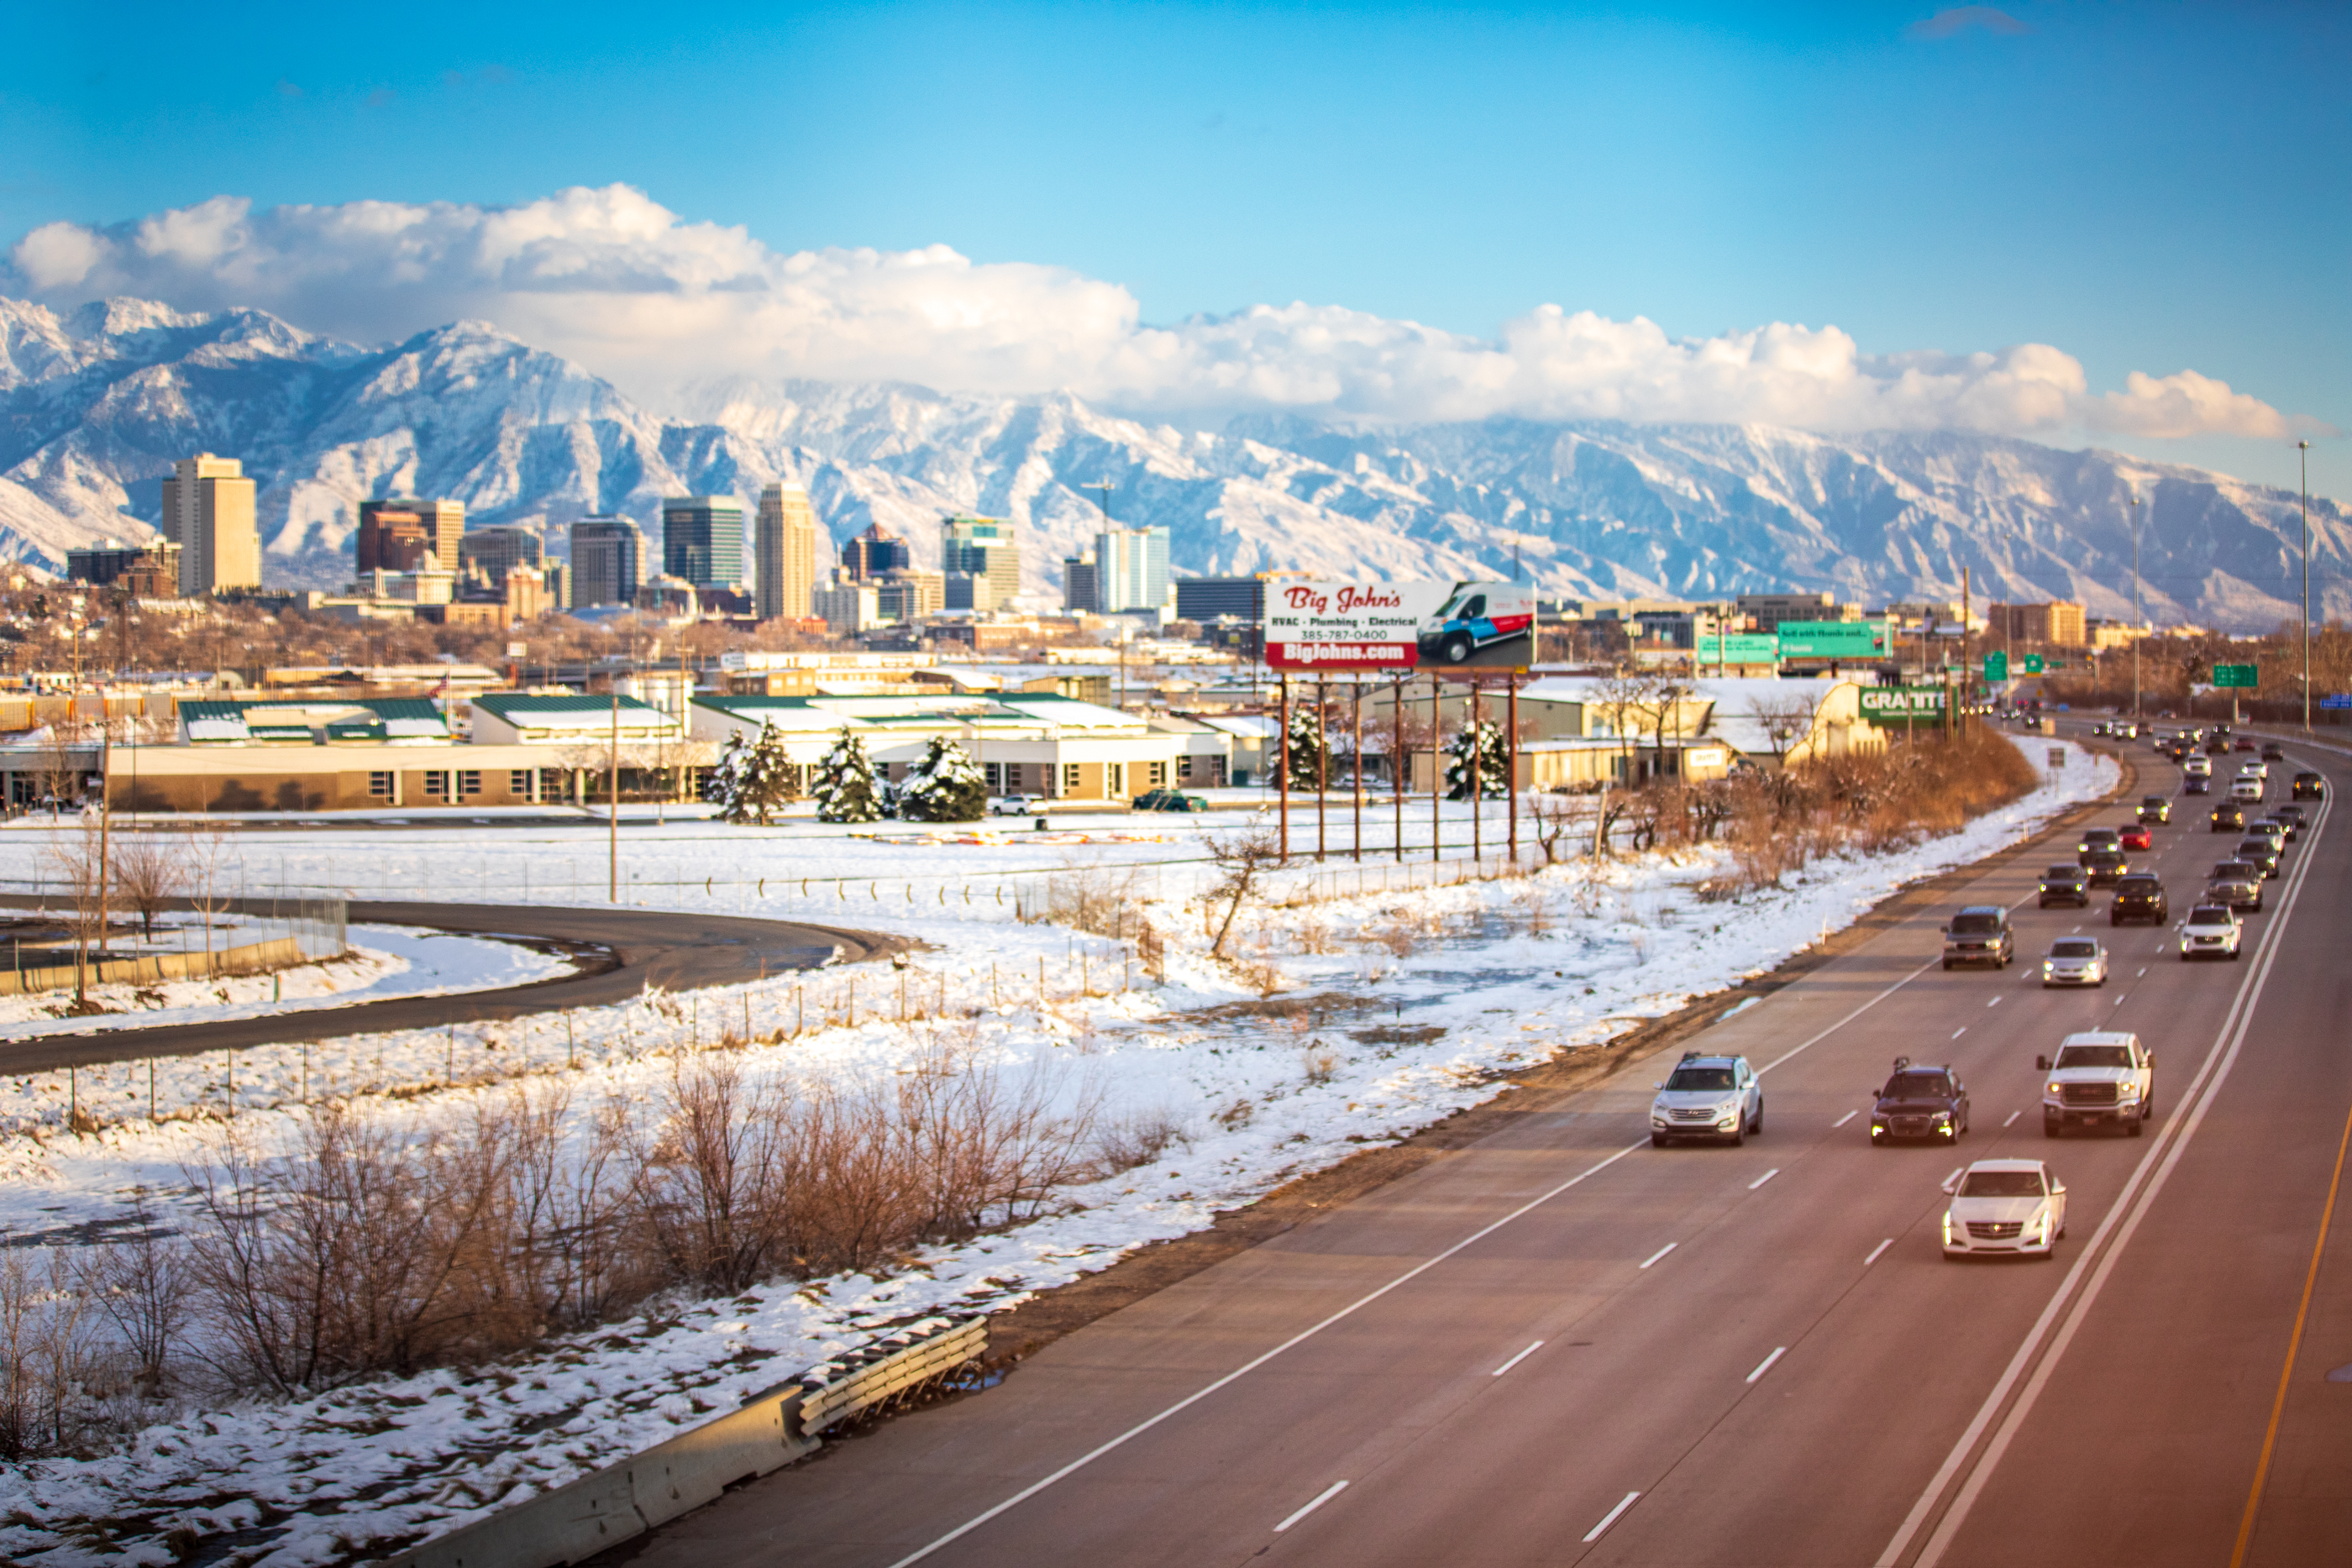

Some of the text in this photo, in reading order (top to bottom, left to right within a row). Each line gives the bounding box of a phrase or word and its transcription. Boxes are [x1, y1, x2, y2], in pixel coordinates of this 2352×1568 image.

[1284, 585, 1400, 615] Big John's
[1272, 617, 1417, 628] HVAC Plumbing Electrical
[1301, 630, 1388, 640] 385-787-0400
[1283, 643, 1405, 663] BigJohns.com
